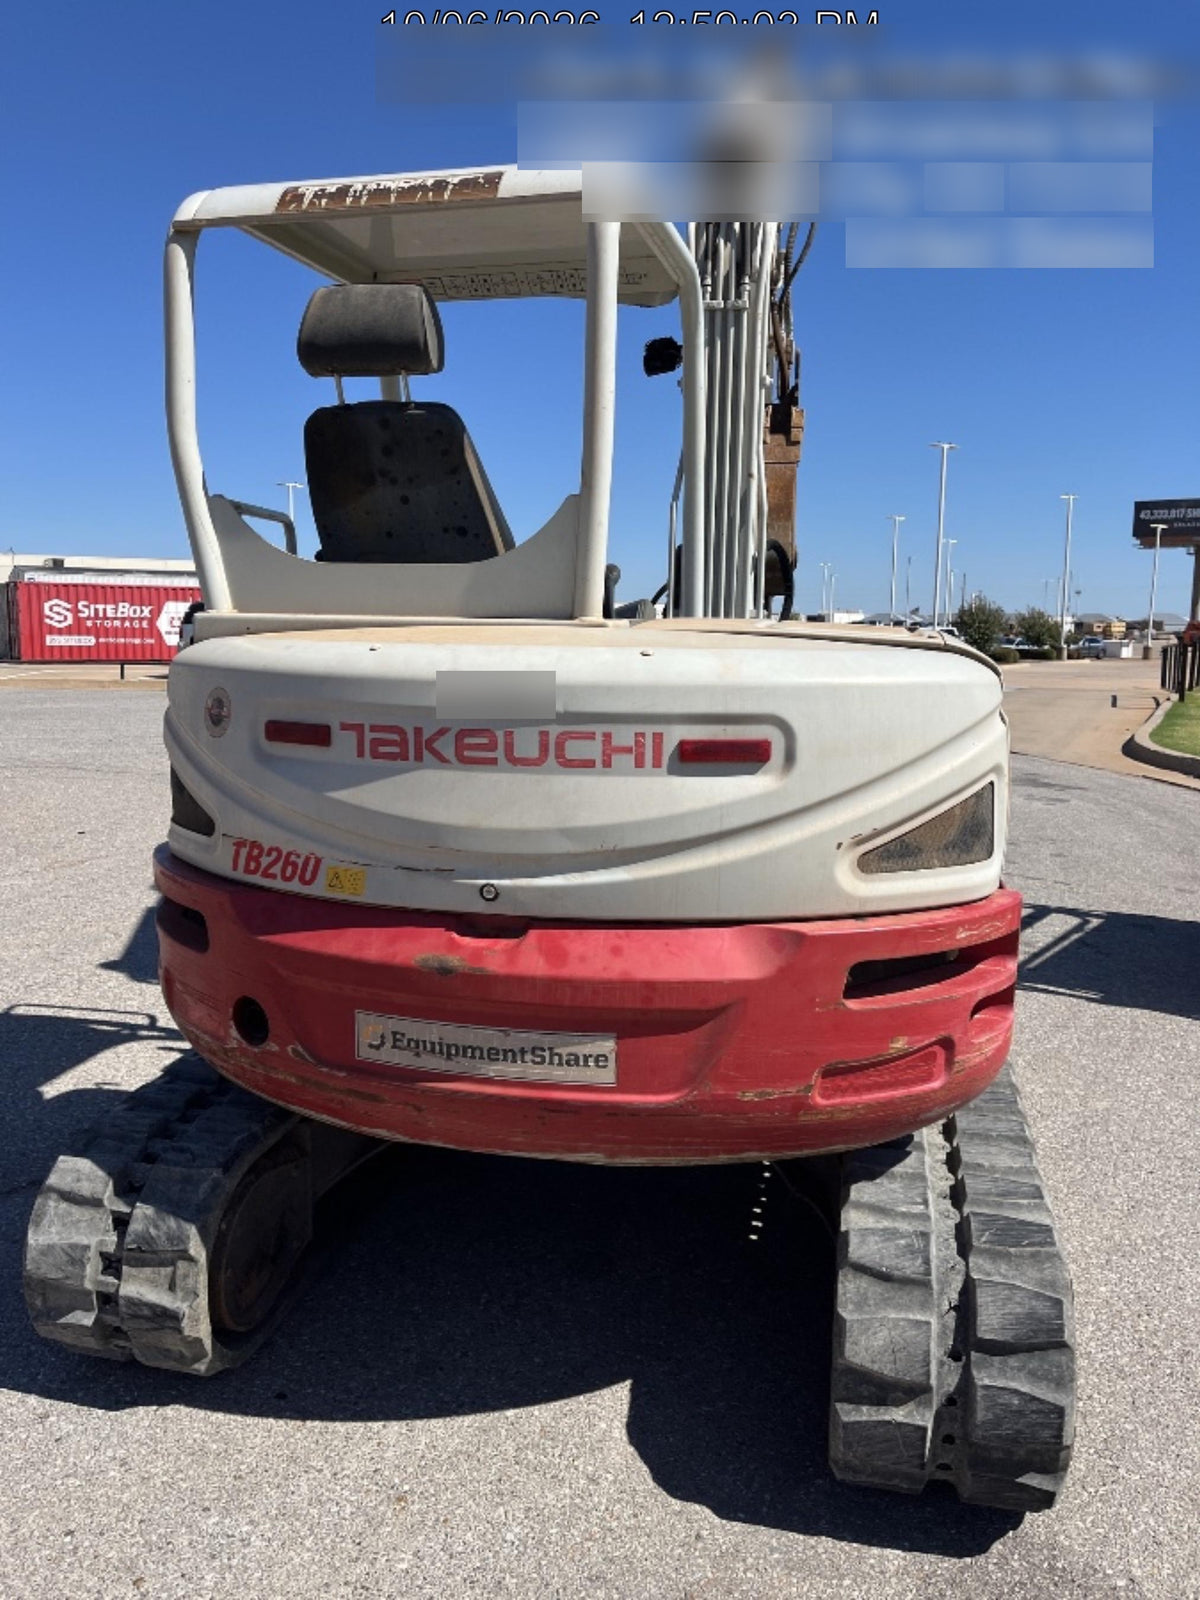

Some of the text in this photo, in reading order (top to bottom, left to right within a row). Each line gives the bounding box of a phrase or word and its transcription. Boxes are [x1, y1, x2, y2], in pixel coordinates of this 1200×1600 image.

[85, 620, 149, 629] STORAGE
[232, 840, 322, 886] TB260
[390, 1030, 609, 1070] EquipmentShare
